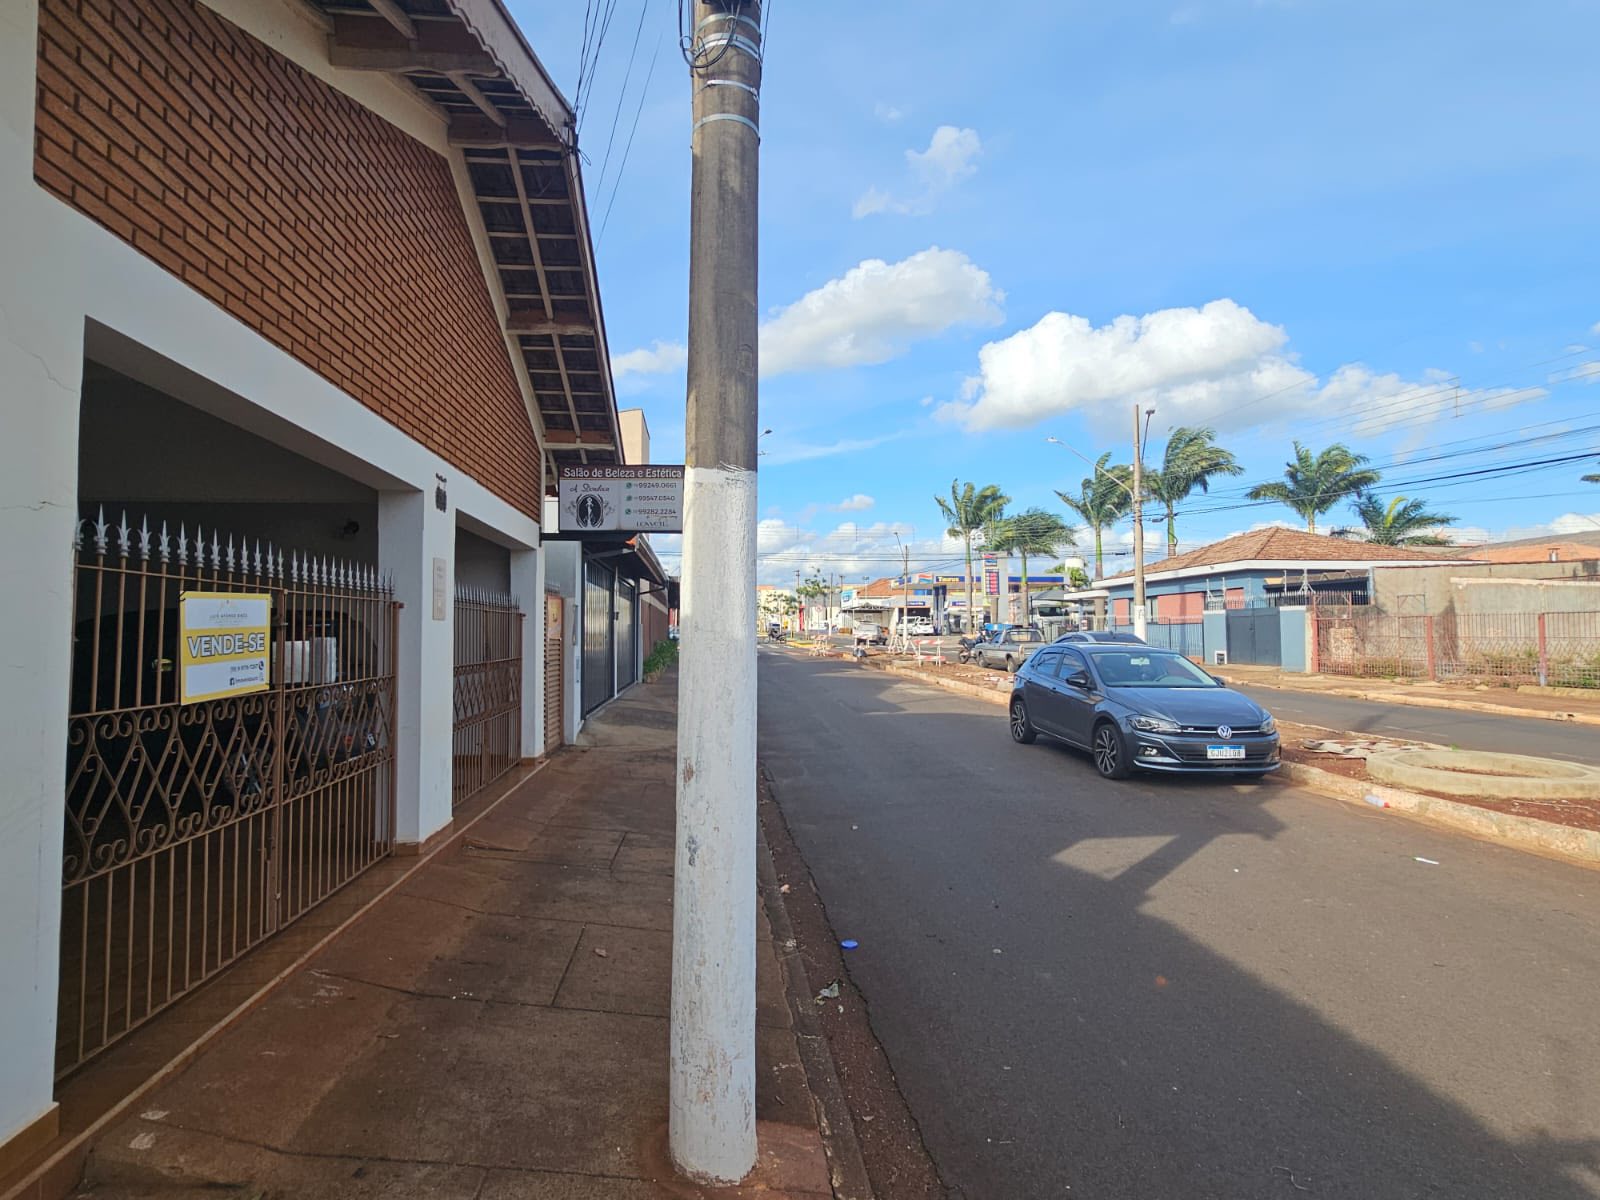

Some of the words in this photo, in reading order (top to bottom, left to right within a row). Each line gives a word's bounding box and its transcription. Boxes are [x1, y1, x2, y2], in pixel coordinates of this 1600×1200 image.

[564, 467, 590, 478] Salão
[591, 467, 603, 478] de
[605, 468, 635, 478] Beleza
[637, 470, 643, 478] e
[645, 467, 682, 478] Estética
[187, 632, 265, 659] VENDE-SE
